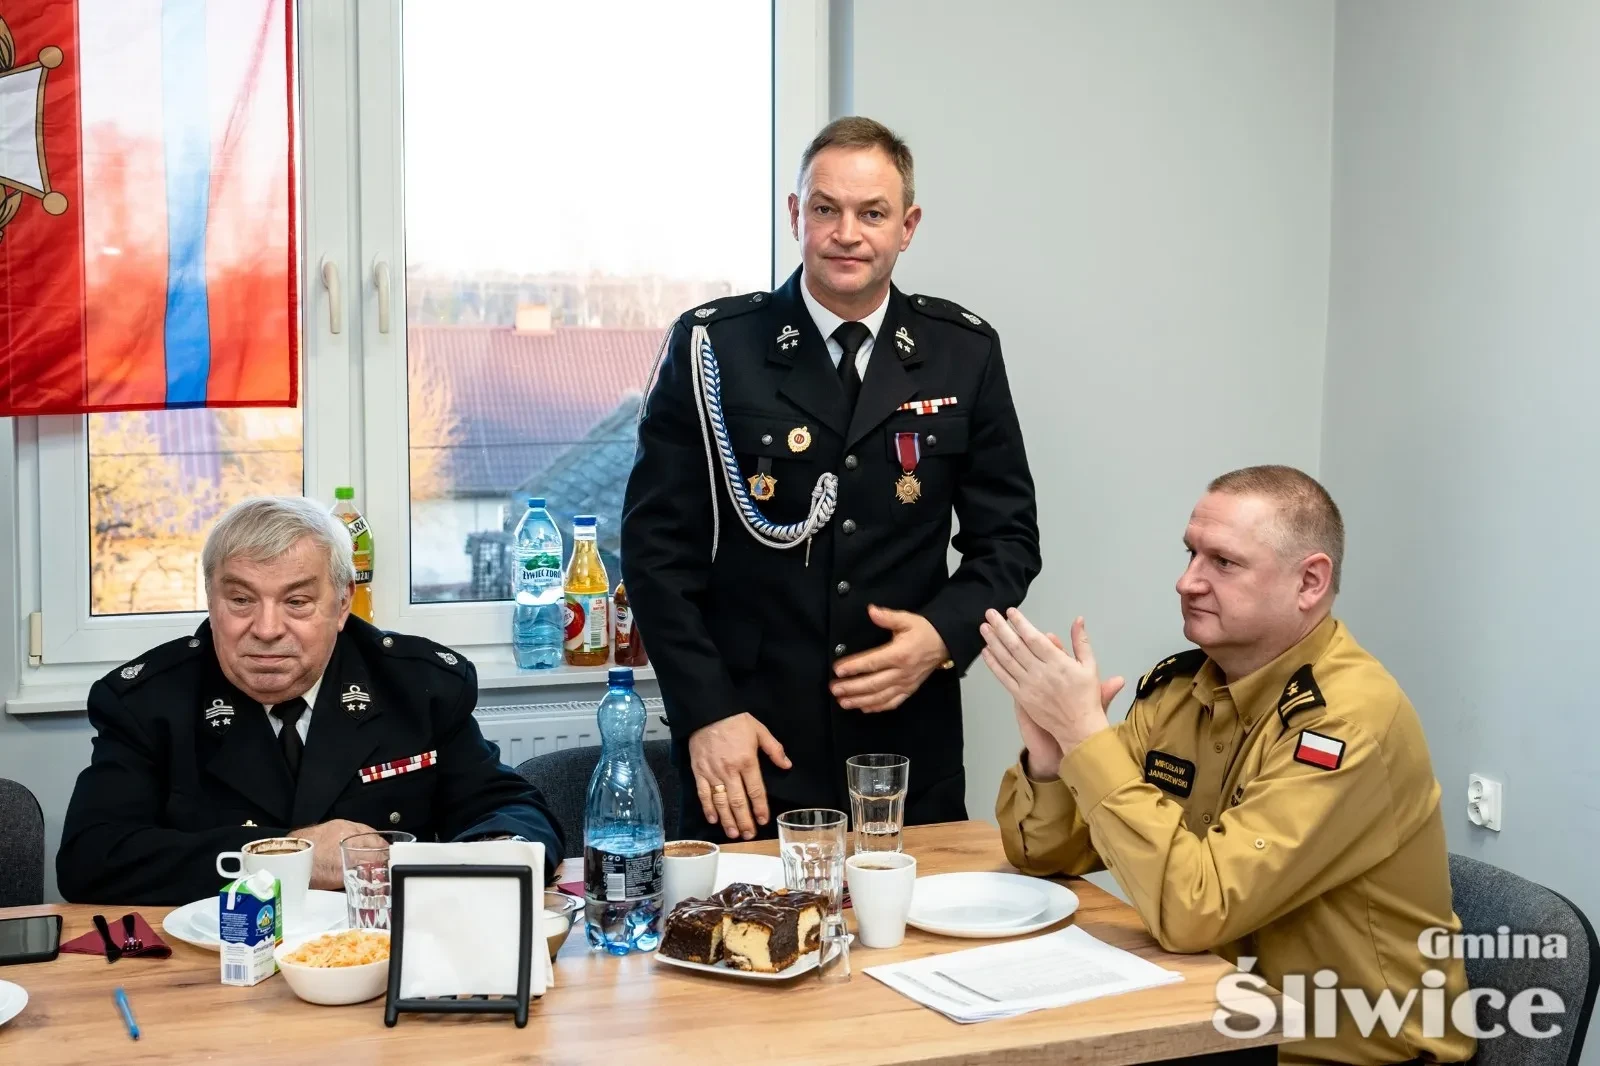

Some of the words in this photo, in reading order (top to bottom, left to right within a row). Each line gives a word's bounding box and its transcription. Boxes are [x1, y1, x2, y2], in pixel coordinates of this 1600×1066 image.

[348, 518, 367, 536] ARK
[1154, 758, 1186, 775] MIROSŁAW
[1147, 768, 1188, 788] JANUSZEWSKI
